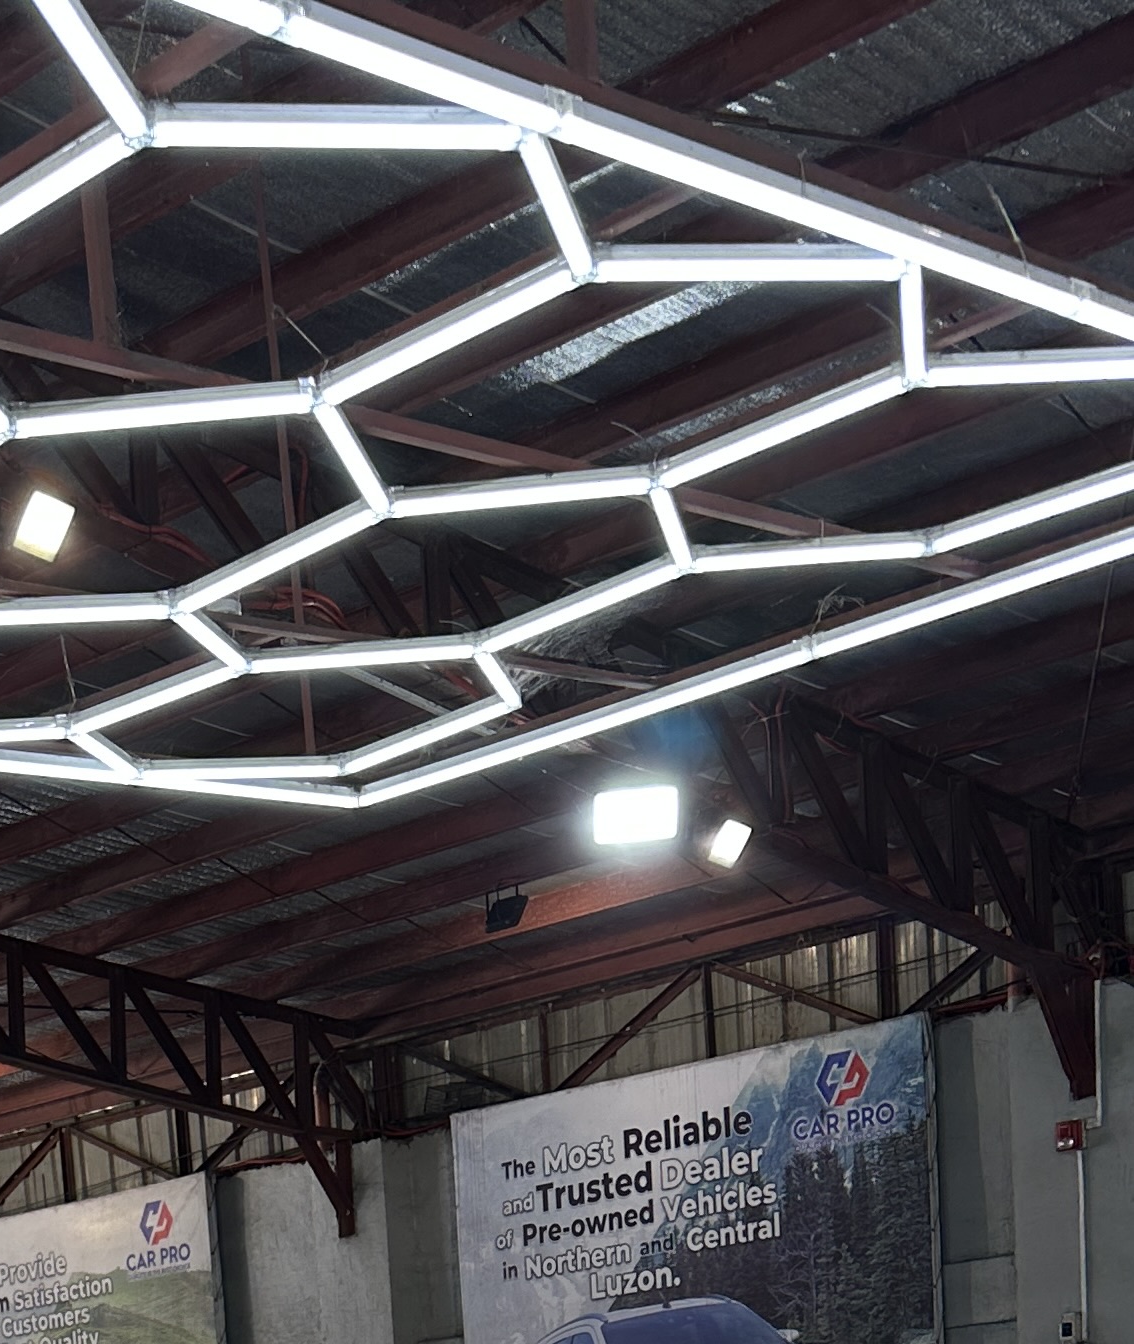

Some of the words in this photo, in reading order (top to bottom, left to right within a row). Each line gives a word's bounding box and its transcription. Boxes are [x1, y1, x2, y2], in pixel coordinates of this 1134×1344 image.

[793, 1113, 840, 1140] CAR
[847, 1102, 895, 1131] PRO
[502, 1158, 535, 1180] The
[543, 1136, 616, 1177] Most
[623, 1106, 753, 1158] Reliable
[502, 1193, 534, 1216] and
[536, 1161, 652, 1211] Trusted
[660, 1147, 763, 1191] Dealer
[496, 1230, 513, 1251] of
[523, 1200, 654, 1246] Pre-owned
[661, 1182, 778, 1222] Vehicles
[126, 1250, 156, 1271] CAR
[160, 1243, 191, 1265] PRO
[502, 1262, 518, 1280] in
[525, 1242, 631, 1280] Northern
[639, 1234, 674, 1256] and
[686, 1212, 781, 1252] Central
[13, 1275, 113, 1312] Satisfaction
[590, 1266, 681, 1300] Luzon.
[1, 1306, 90, 1338] Customers
